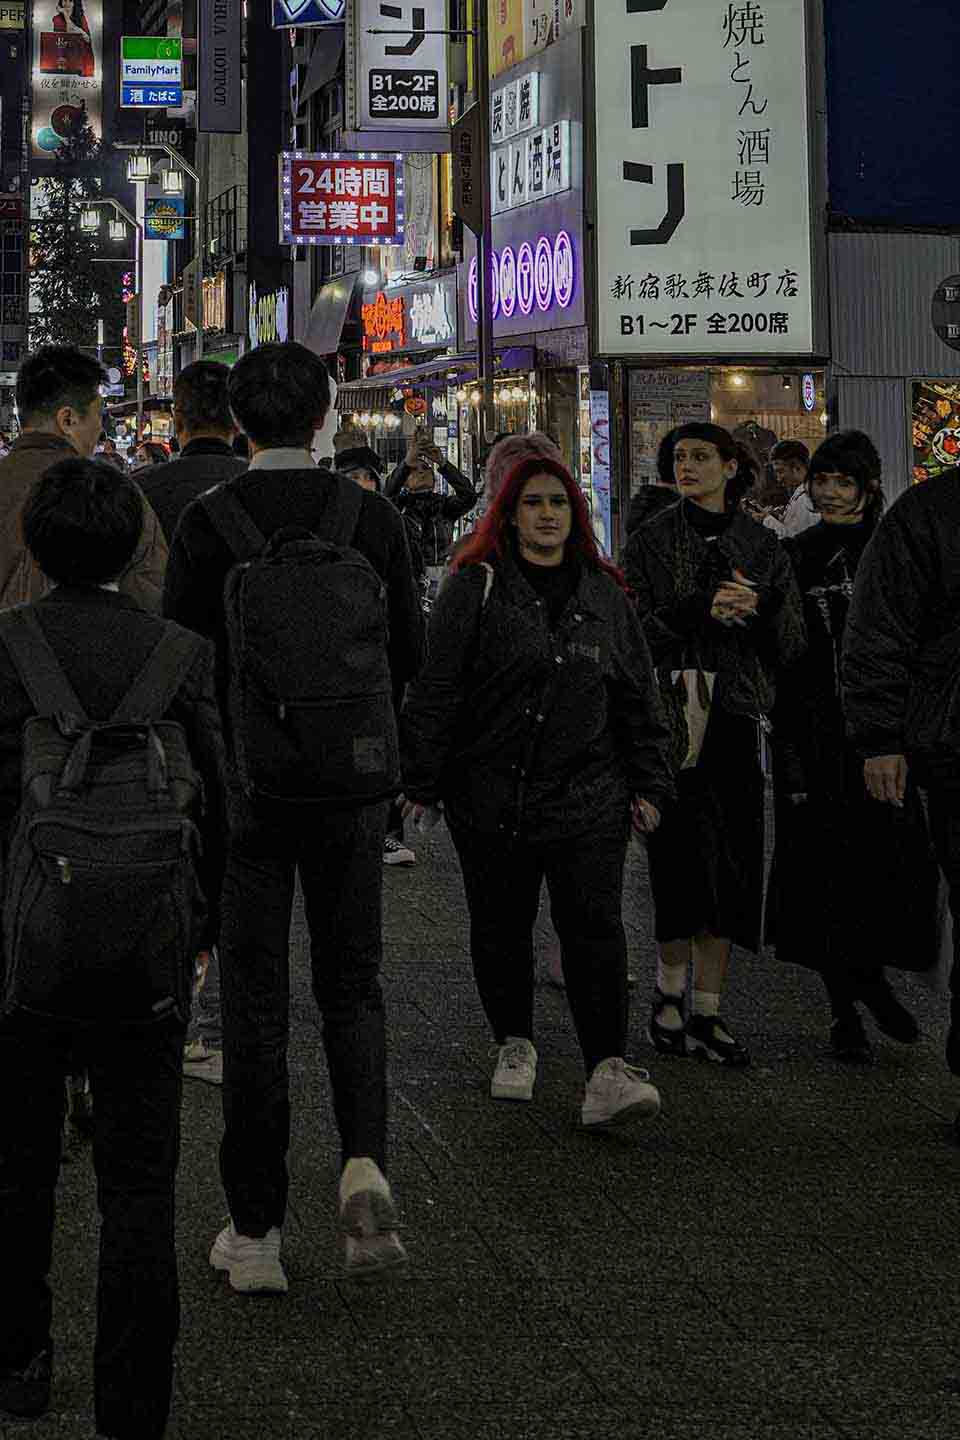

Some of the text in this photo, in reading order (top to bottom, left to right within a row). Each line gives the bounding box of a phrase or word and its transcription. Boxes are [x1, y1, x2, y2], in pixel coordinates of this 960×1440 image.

[125, 64, 179, 76] FamilyMart
[130, 89, 177, 103] 酒 たばこ
[371, 95, 437, 113] 全200席
[722, 1, 769, 207] 焼とん酒場
[297, 167, 390, 198] 24時間
[297, 201, 389, 232] 営業中
[611, 268, 799, 301] 新宿歌舞伎町店
[707, 312, 789, 336] 全200席
